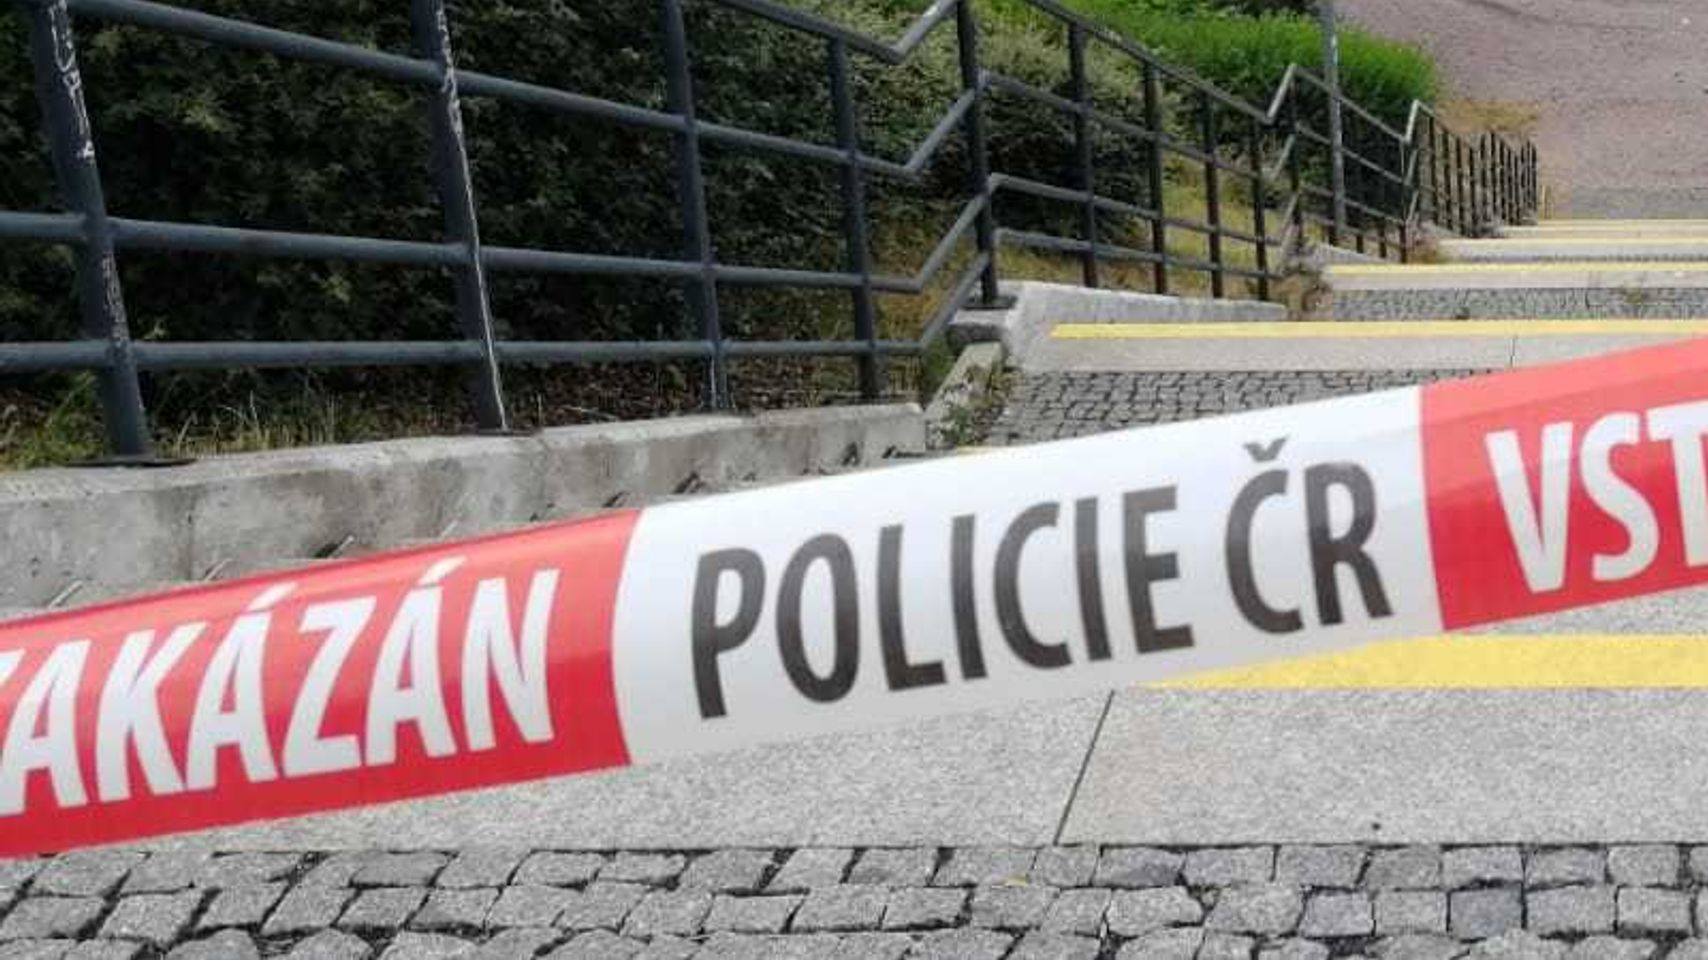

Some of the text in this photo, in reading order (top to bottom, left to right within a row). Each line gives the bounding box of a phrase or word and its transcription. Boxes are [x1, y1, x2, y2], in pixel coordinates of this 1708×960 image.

[0, 556, 560, 816] AKÁZÁN
[690, 484, 1195, 719] POLICIE
[1223, 436, 1396, 634] ČR
